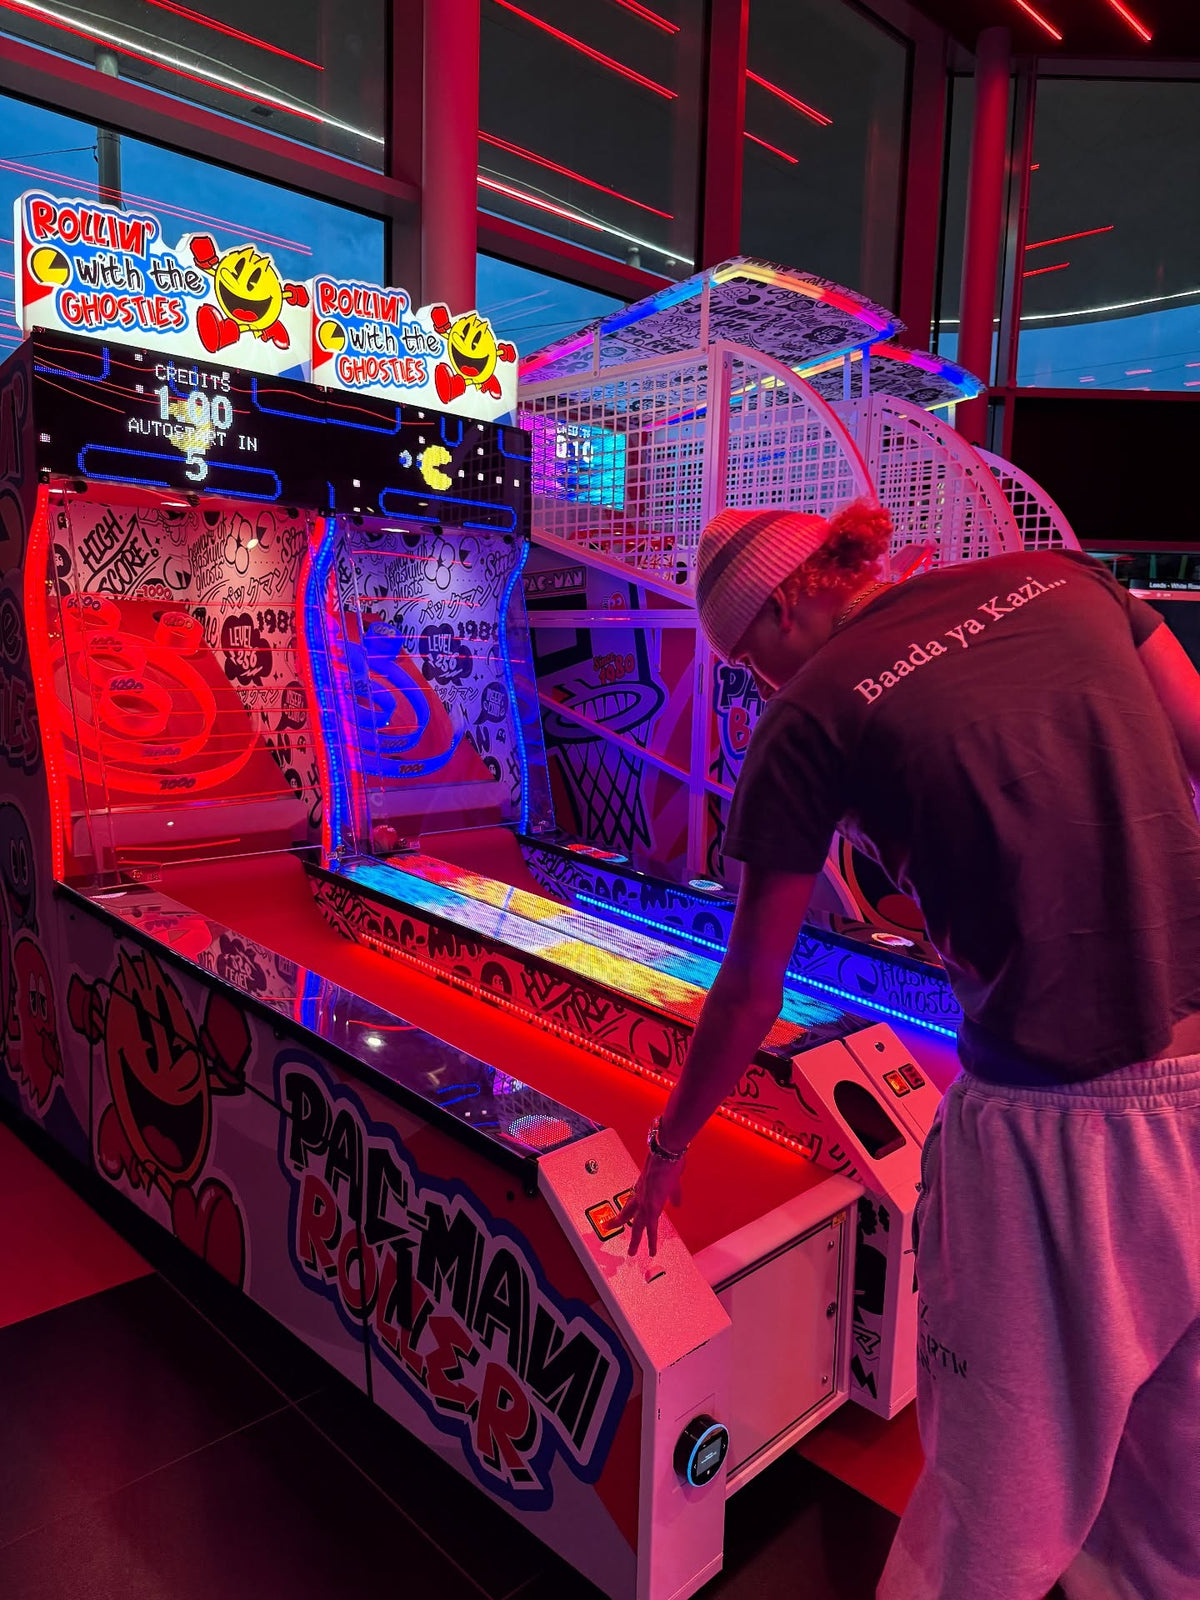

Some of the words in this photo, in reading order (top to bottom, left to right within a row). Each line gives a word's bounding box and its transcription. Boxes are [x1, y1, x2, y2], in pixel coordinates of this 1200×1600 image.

[75, 254, 143, 290] with
[150, 258, 205, 294] the
[61, 292, 184, 328] GHOSTIES
[350, 325, 398, 354] with
[402, 326, 441, 354] the
[155, 364, 231, 392] CREDITS
[340, 356, 425, 384] GHOSTIES
[154, 385, 233, 430] 1.00
[128, 417, 227, 447] AUTOSTART
[238, 435, 258, 452] IN
[185, 447, 208, 482] 5
[79, 509, 125, 573] HIGH
[229, 625, 252, 649] LEVEL
[428, 634, 452, 655] LEVEL
[236, 648, 258, 670] 256
[600, 653, 635, 685] 1980
[853, 643, 947, 704] Baada
[945, 619, 985, 648] ya
[283, 1071, 611, 1453] PAC-MAN
[301, 1174, 543, 1488] ROLLER
